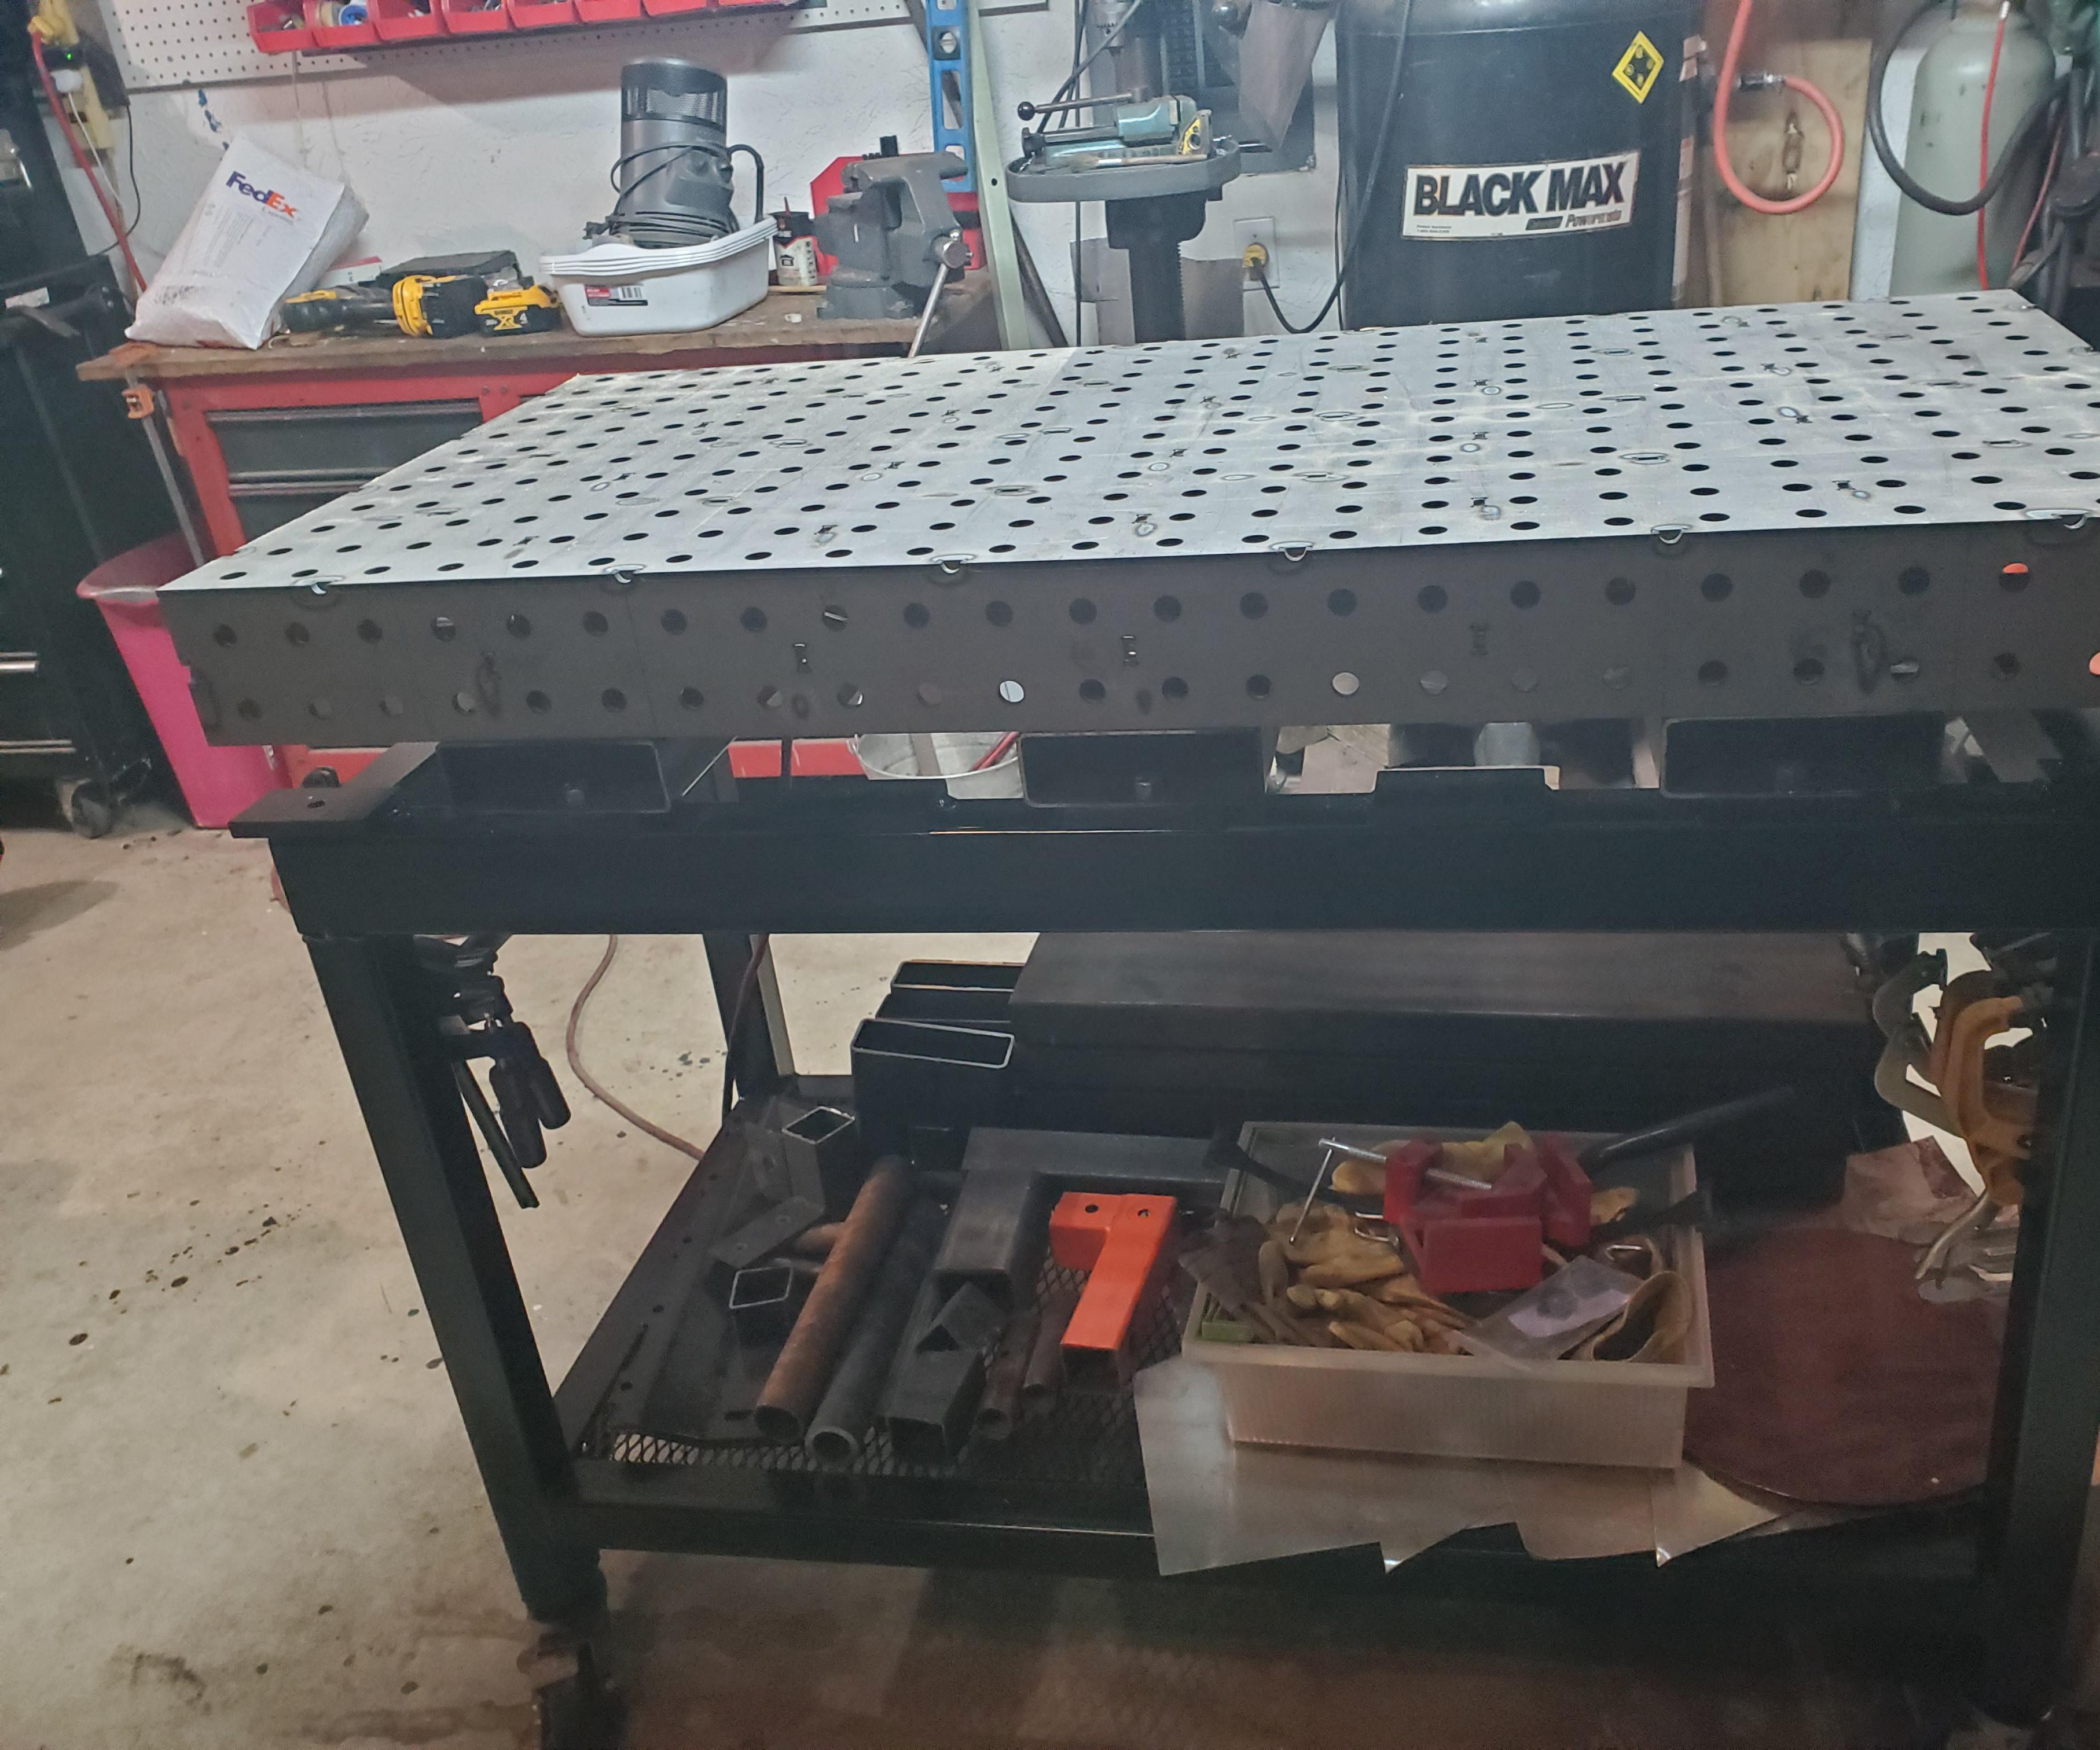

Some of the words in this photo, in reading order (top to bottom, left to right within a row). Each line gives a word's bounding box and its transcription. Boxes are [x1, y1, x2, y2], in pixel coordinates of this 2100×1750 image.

[225, 171, 298, 218] FedEx
[1414, 170, 1545, 216] BLACK
[1546, 162, 1627, 212] MAX
